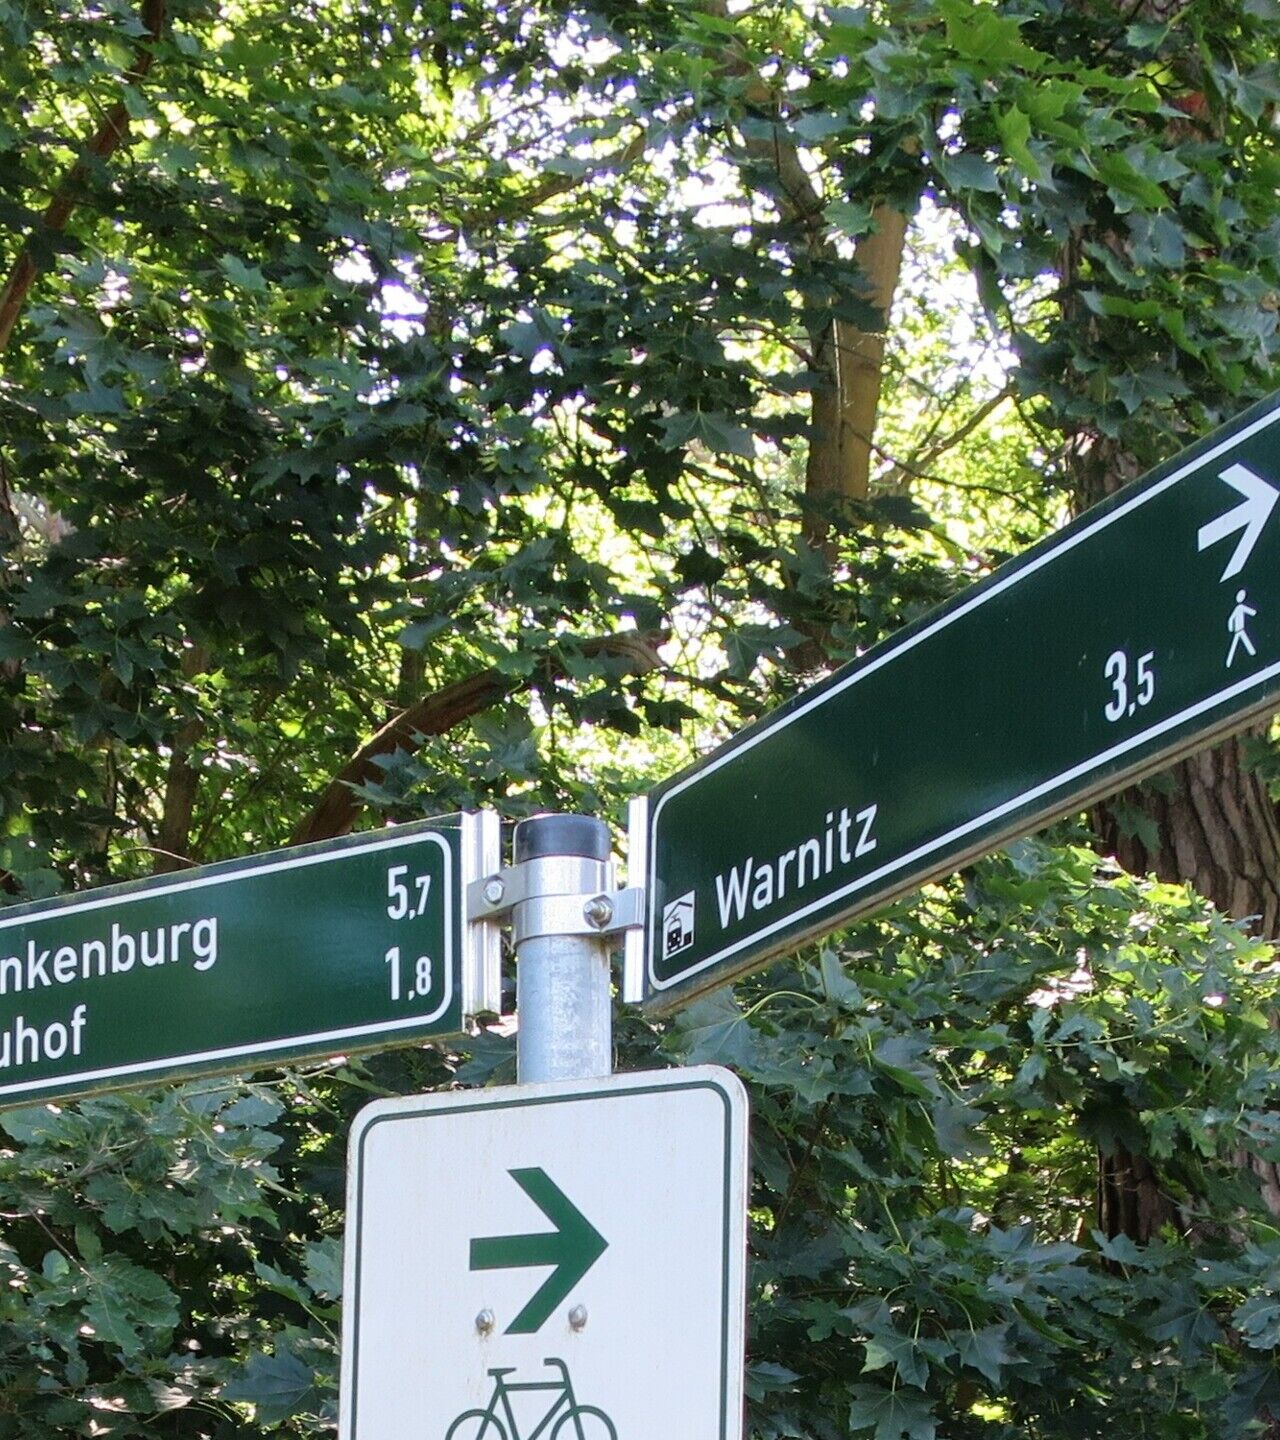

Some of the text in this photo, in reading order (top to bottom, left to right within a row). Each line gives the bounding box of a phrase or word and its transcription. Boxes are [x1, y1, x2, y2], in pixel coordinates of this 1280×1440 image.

[715, 650, 1155, 929] Warnitz 3,5
[387, 864, 431, 920] 5,7
[385, 946, 432, 1001] 1,8
